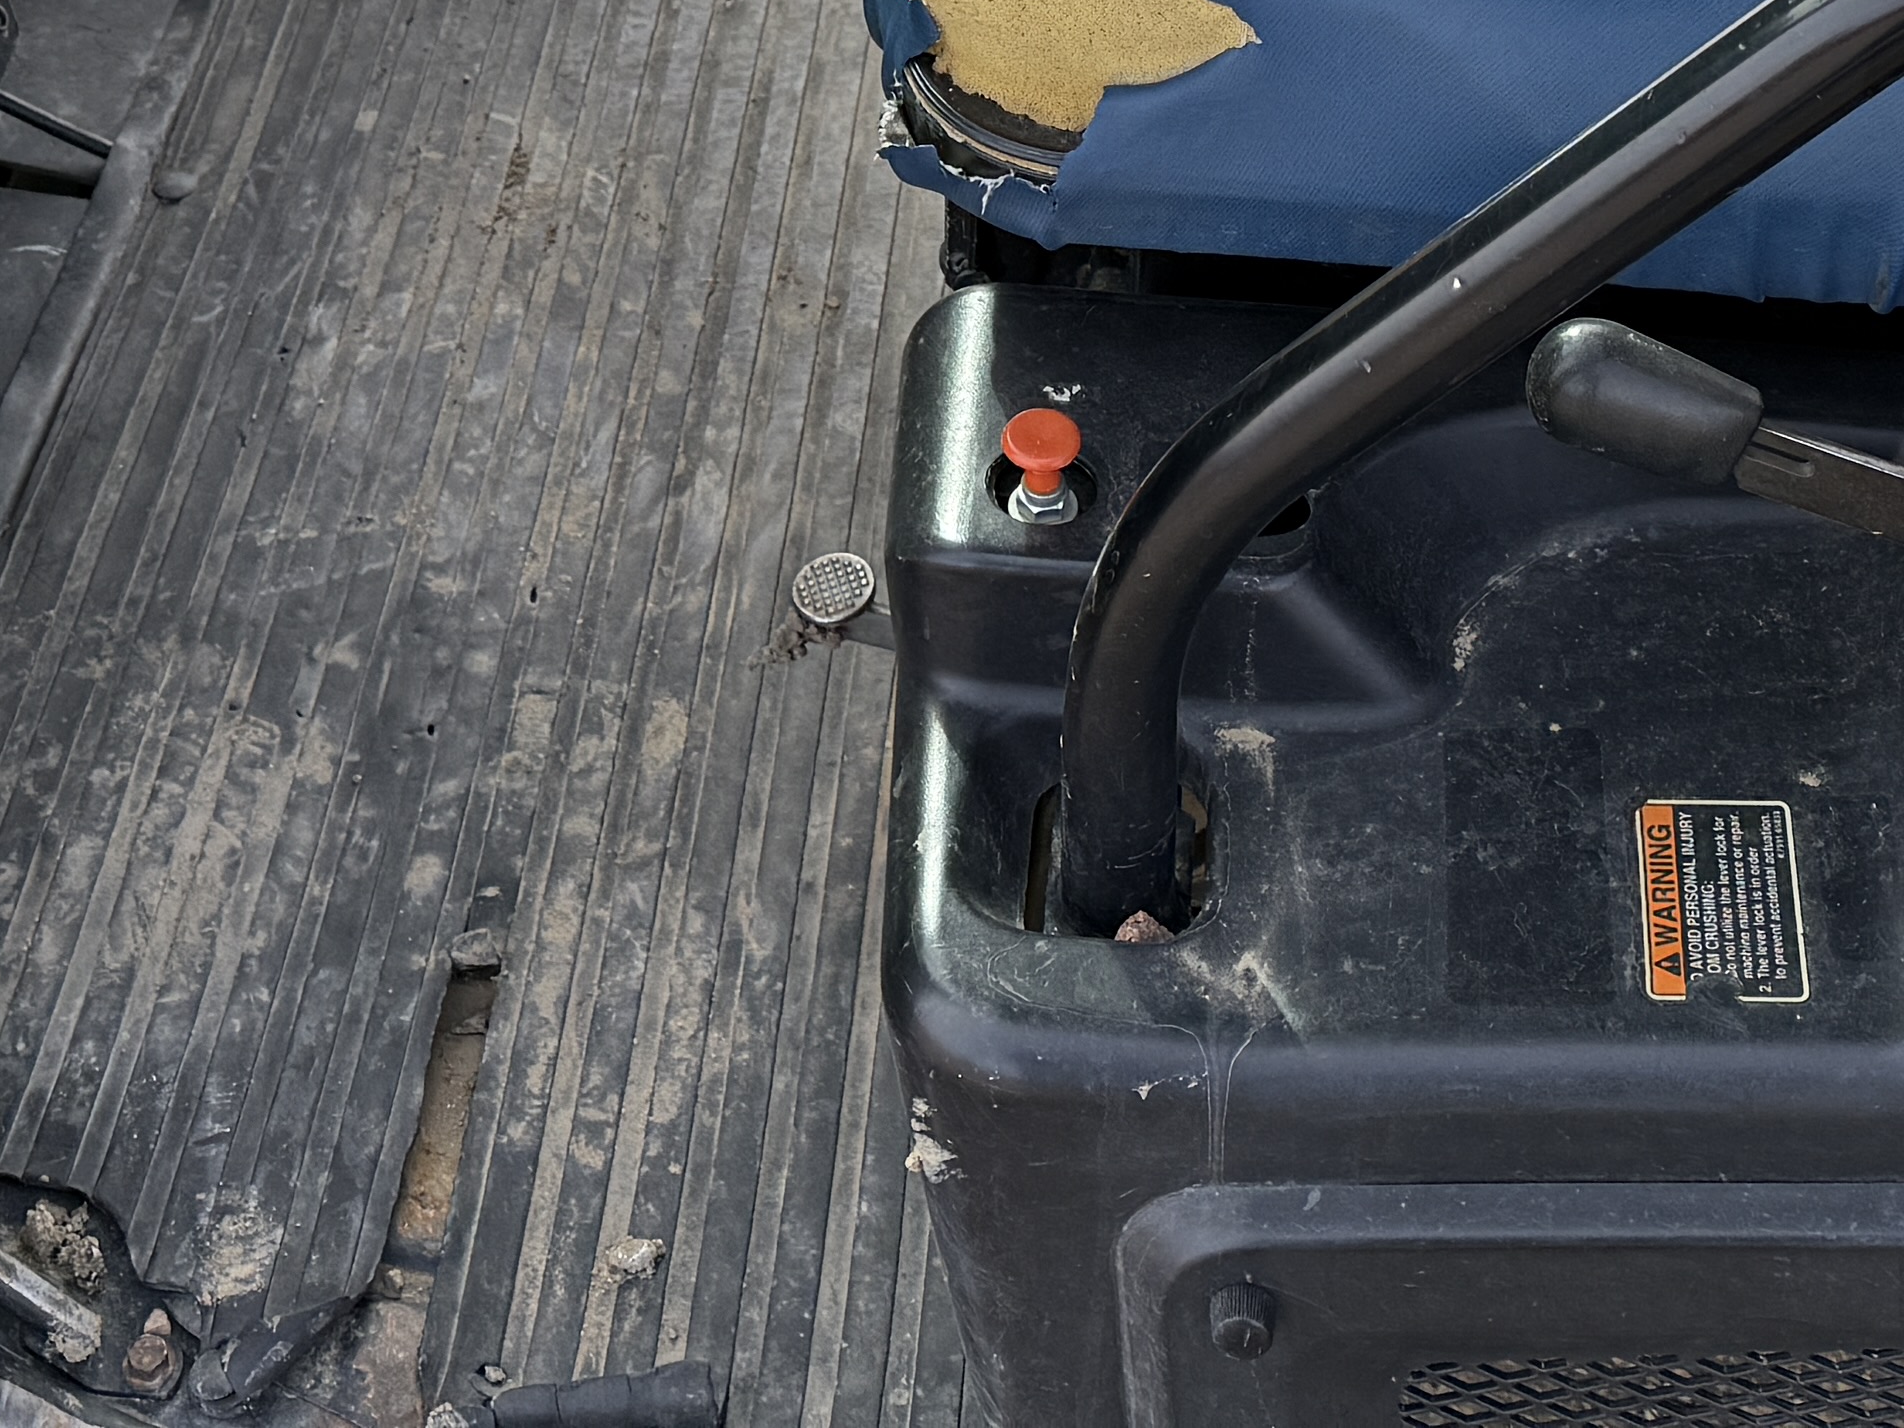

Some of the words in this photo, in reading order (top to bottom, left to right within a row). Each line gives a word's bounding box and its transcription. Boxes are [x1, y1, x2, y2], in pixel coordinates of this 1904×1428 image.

[1678, 811, 1695, 856] INJURY
[1712, 816, 1725, 832] for
[1729, 811, 1744, 845] repair.
[1759, 812, 1775, 864] actuation.
[1714, 833, 1727, 856] lock
[1732, 846, 1743, 859] or
[1716, 858, 1730, 885] lever
[1746, 846, 1760, 876] order
[1647, 824, 1678, 946] WARNING
[1682, 858, 1700, 926] PERSONAL
[1718, 886, 1732, 904] the
[1734, 860, 1749, 929] maintenance
[1748, 877, 1761, 888] in
[1751, 890, 1763, 900] is
[1763, 866, 1781, 921] accidental
[1700, 880, 1719, 950] CRUSHING:
[1720, 906, 1734, 939] utilize
[1751, 903, 1765, 926] lock
[1686, 928, 1703, 969] AVOID
[1723, 941, 1736, 960] not
[1739, 931, 1753, 979] machine
[1755, 928, 1768, 956] lever
[1769, 923, 1788, 965] prevent
[1756, 957, 1770, 979] The
[1774, 967, 1787, 980] to
[1758, 981, 1772, 993] 2.
